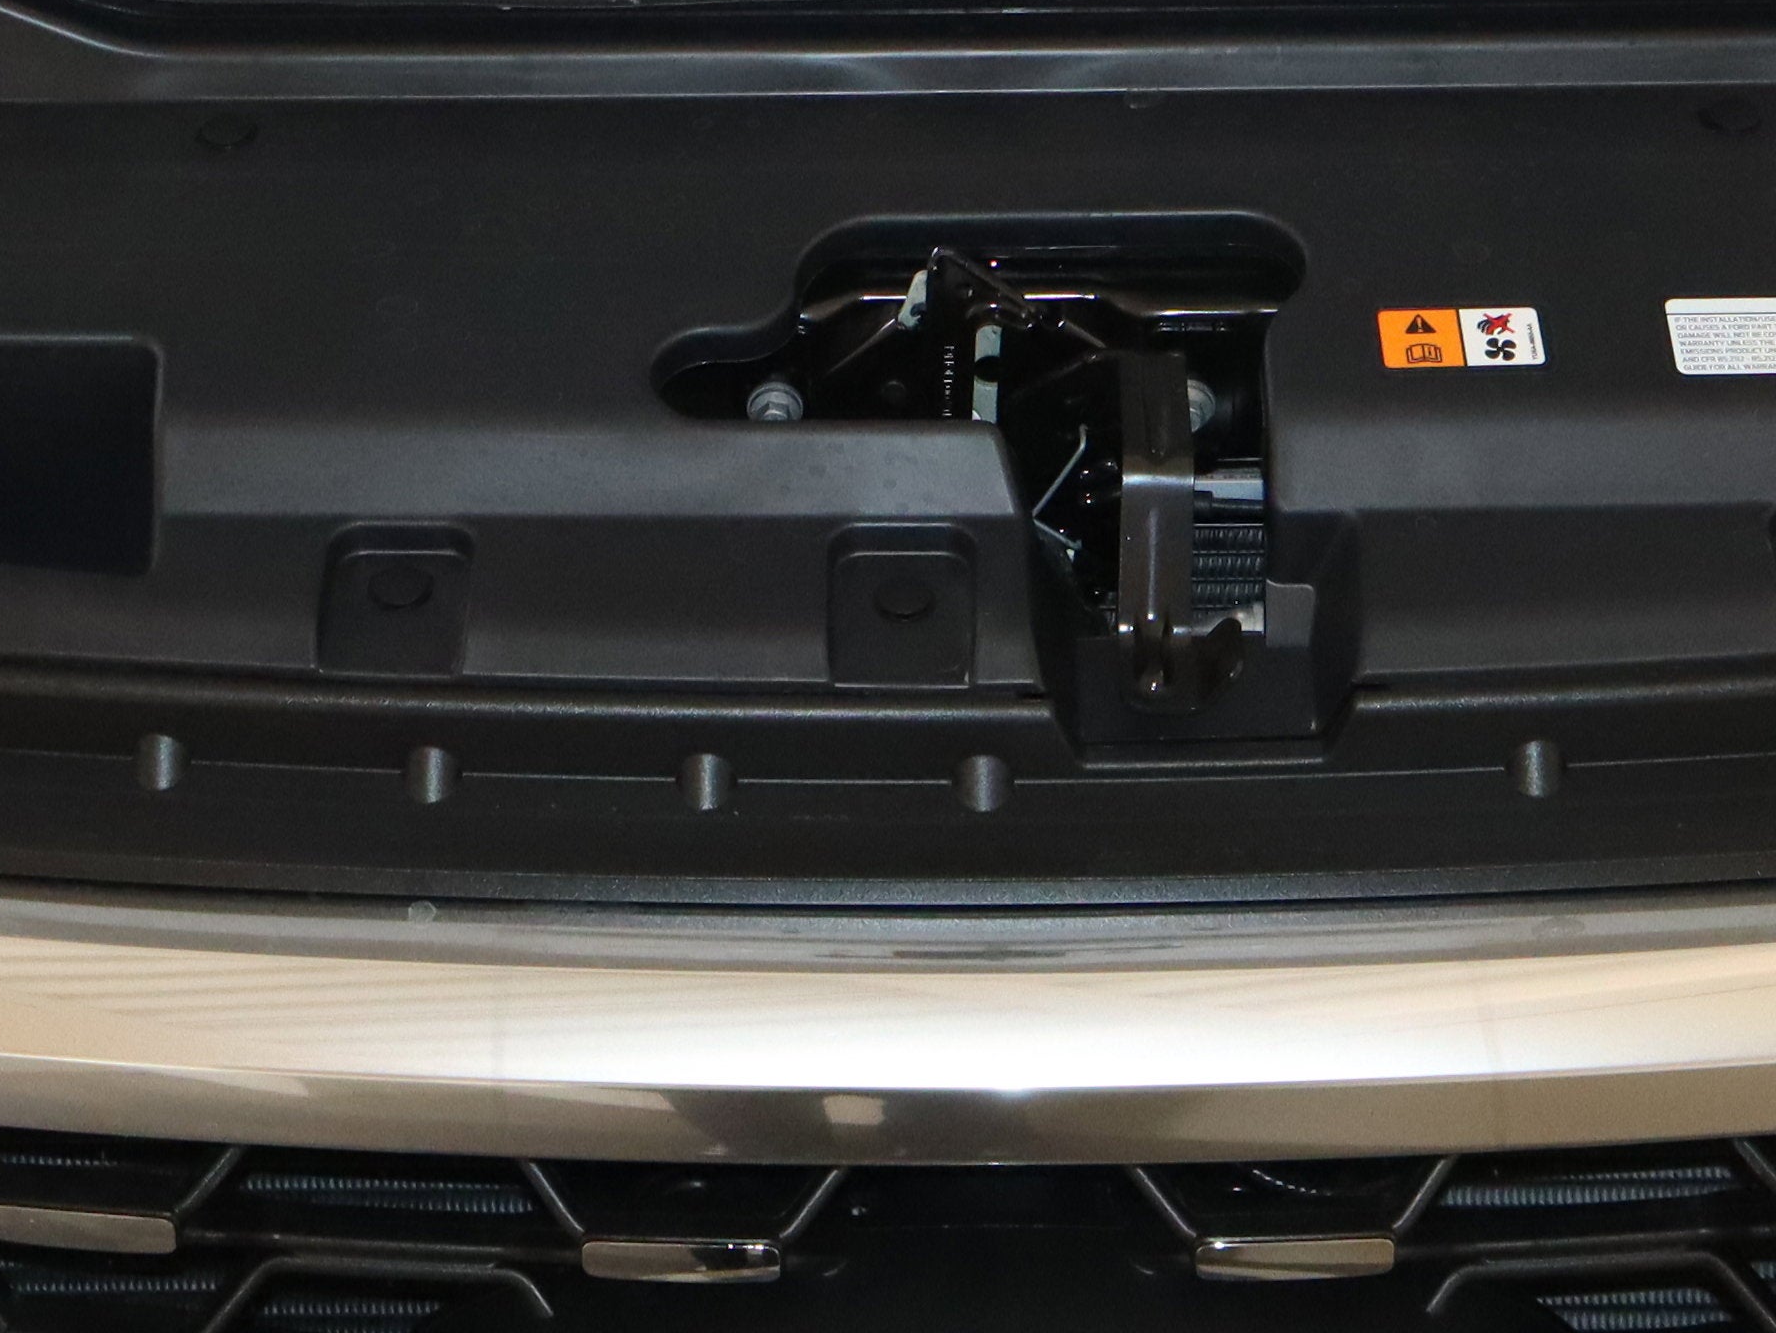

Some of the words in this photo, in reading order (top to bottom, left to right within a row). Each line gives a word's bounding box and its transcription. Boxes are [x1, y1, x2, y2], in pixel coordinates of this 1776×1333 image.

[1728, 323, 1749, 331] FORD
[1713, 331, 1732, 339] WILL
[1725, 347, 1763, 355] PRODUCT
[1708, 363, 1725, 371] FOR
